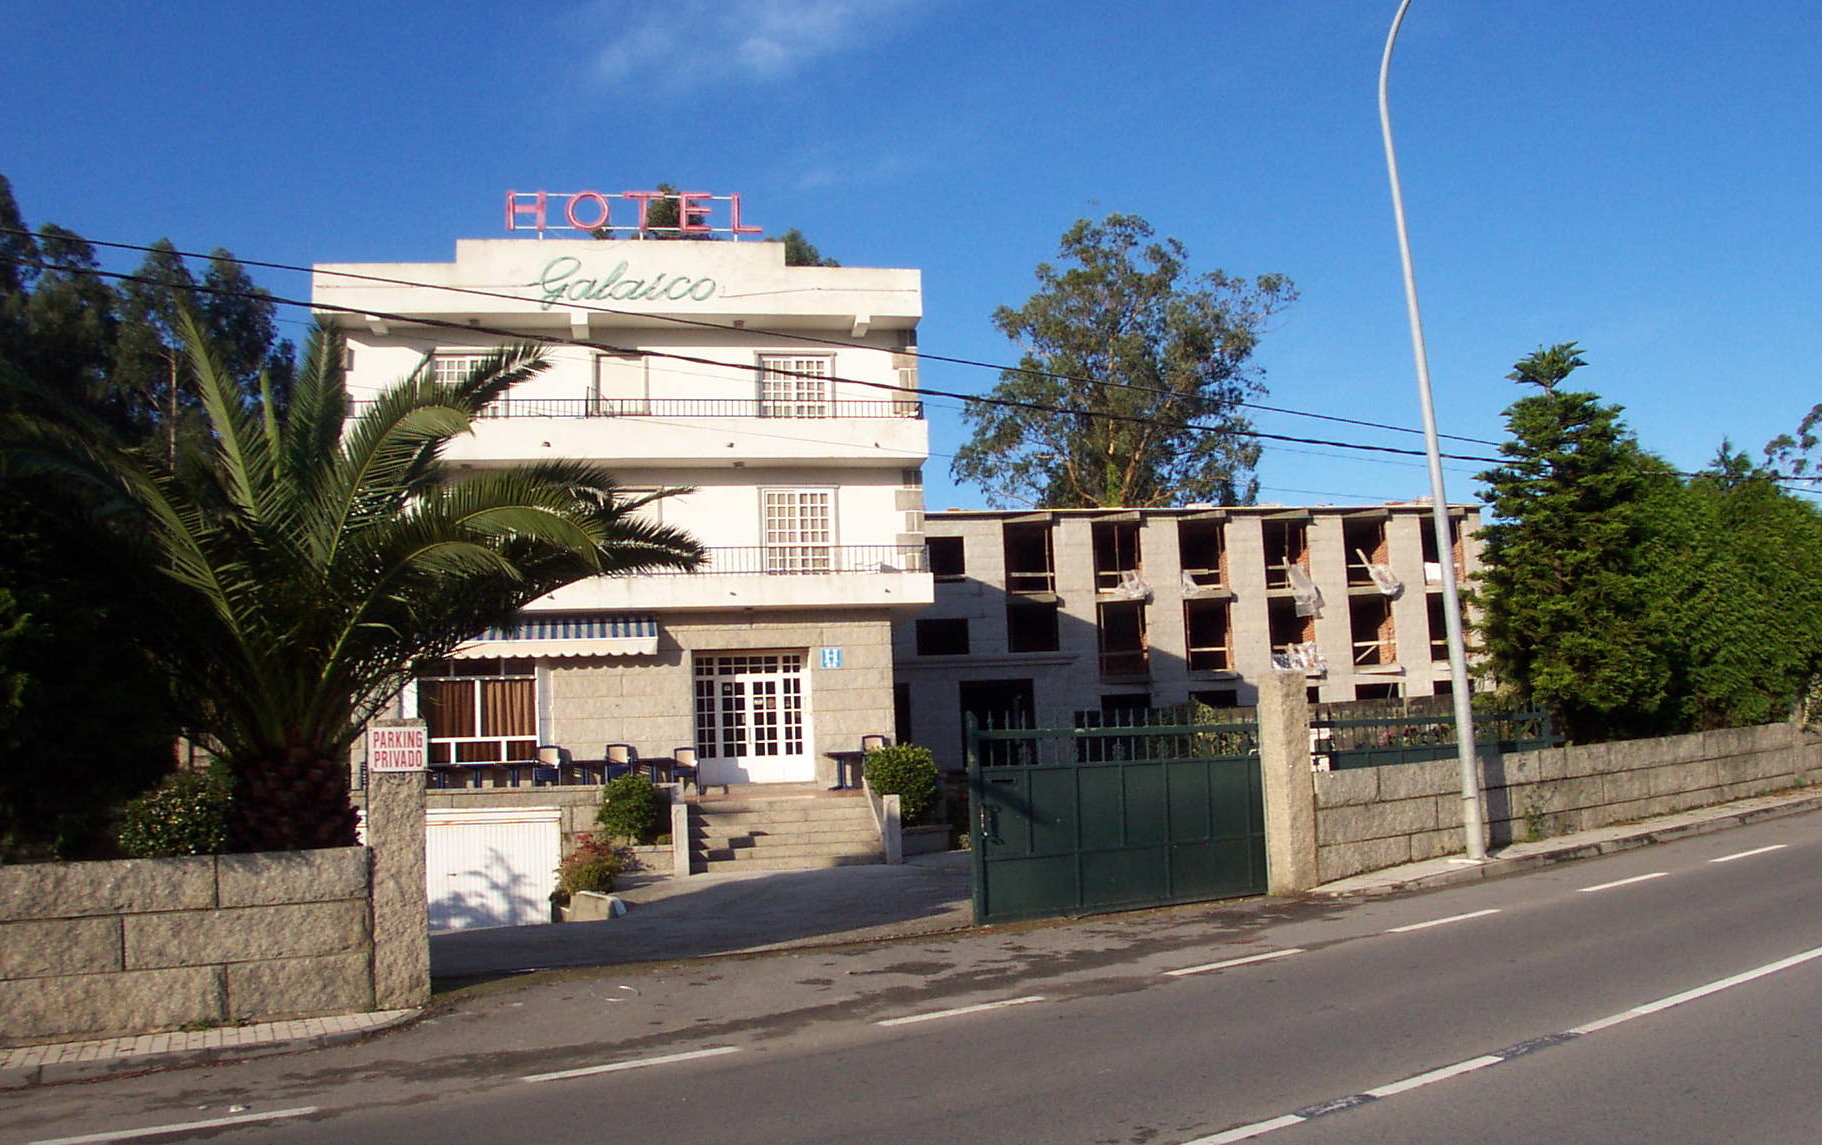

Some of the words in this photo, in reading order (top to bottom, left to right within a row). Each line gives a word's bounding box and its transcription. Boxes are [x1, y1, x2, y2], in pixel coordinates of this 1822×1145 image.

[506, 190, 763, 234] HOTEL
[373, 731, 423, 748] PARKING
[374, 750, 423, 768] PRIVADO
